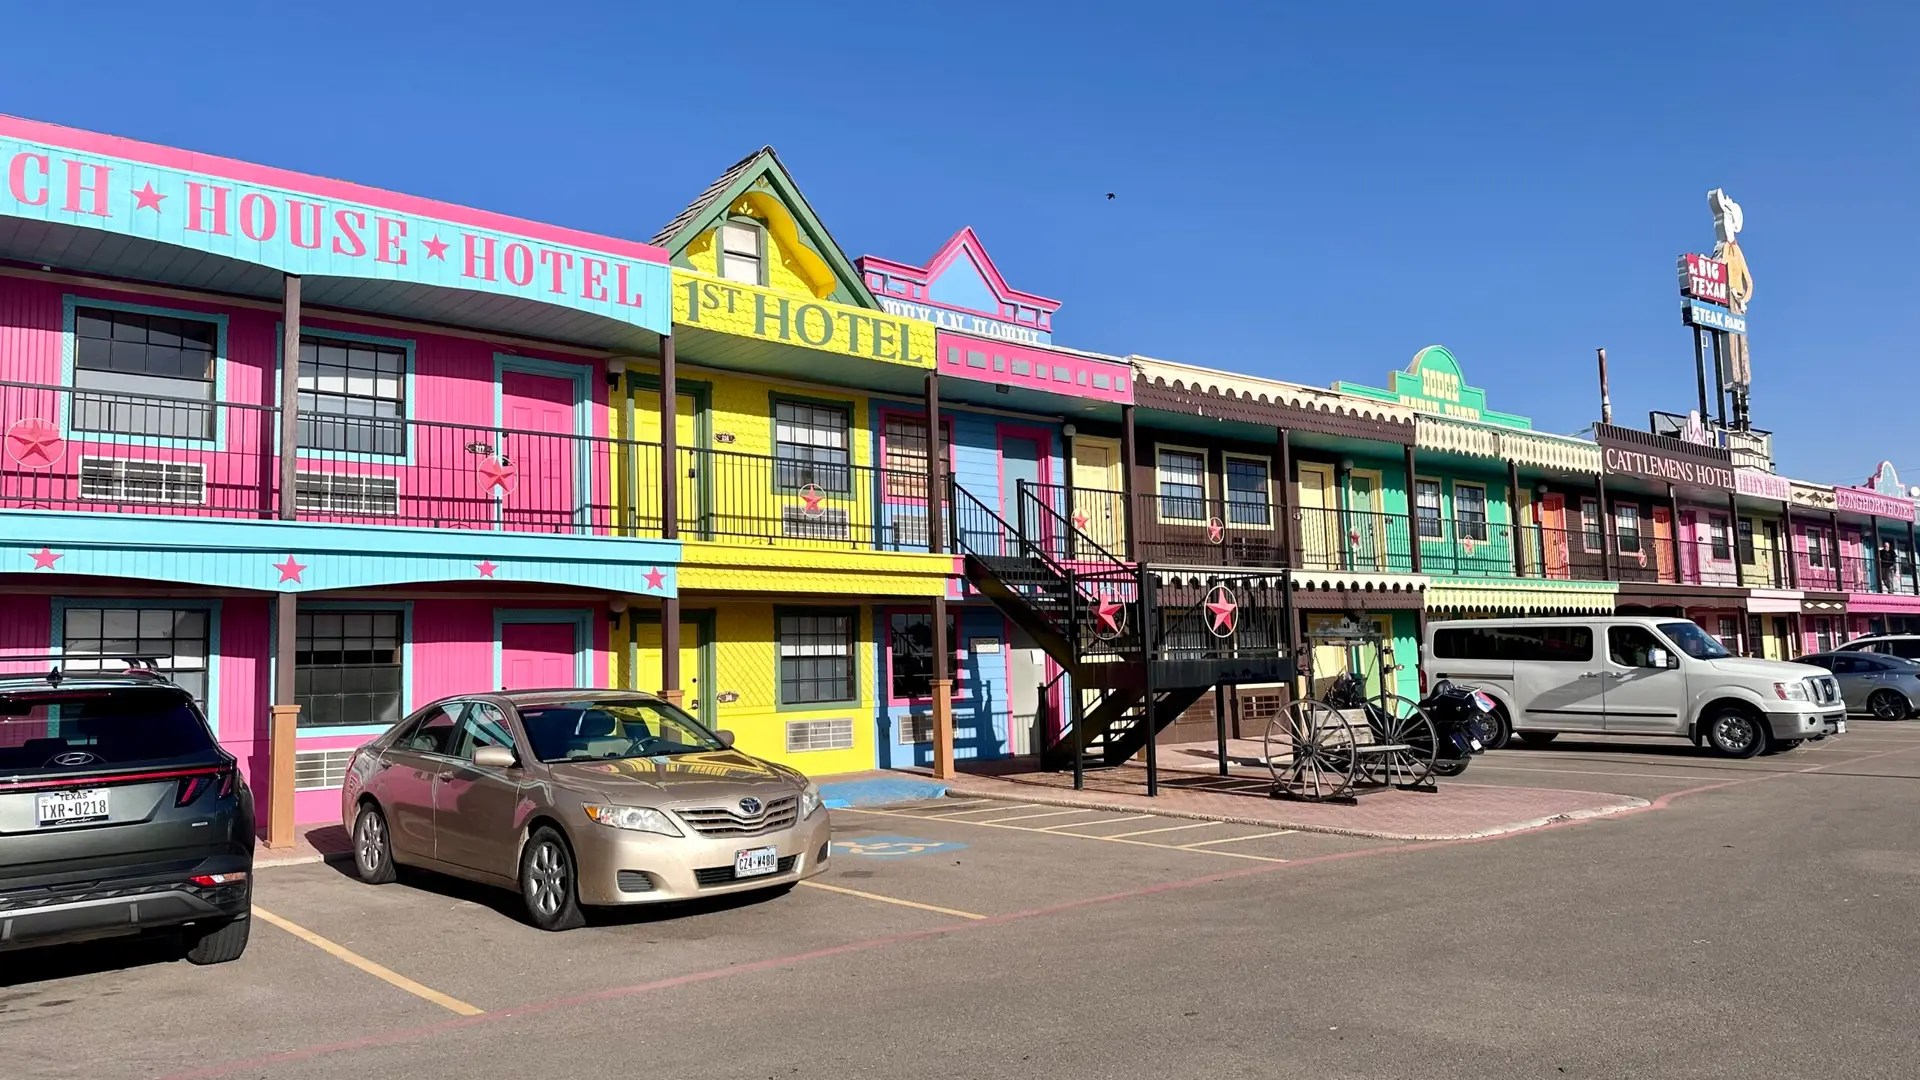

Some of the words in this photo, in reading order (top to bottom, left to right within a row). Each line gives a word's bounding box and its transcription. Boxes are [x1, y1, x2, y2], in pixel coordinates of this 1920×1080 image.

[184, 181, 408, 266] HOUSE
[460, 233, 642, 308] HOTEL
[1698, 259, 1719, 280] BIG
[1691, 276, 1727, 299] TEXAN
[680, 280, 742, 323] 1ST
[753, 292, 923, 363] HOTEL
[1692, 306, 1724, 328] STEAK
[1421, 367, 1459, 403] DODGE
[1606, 448, 1694, 482] CATTLEMENS
[1696, 464, 1736, 490] HOTEL
[1837, 490, 1887, 515] LONGHORN
[1886, 500, 1914, 520] HOTEL
[60, 791, 88, 801] TEXAS
